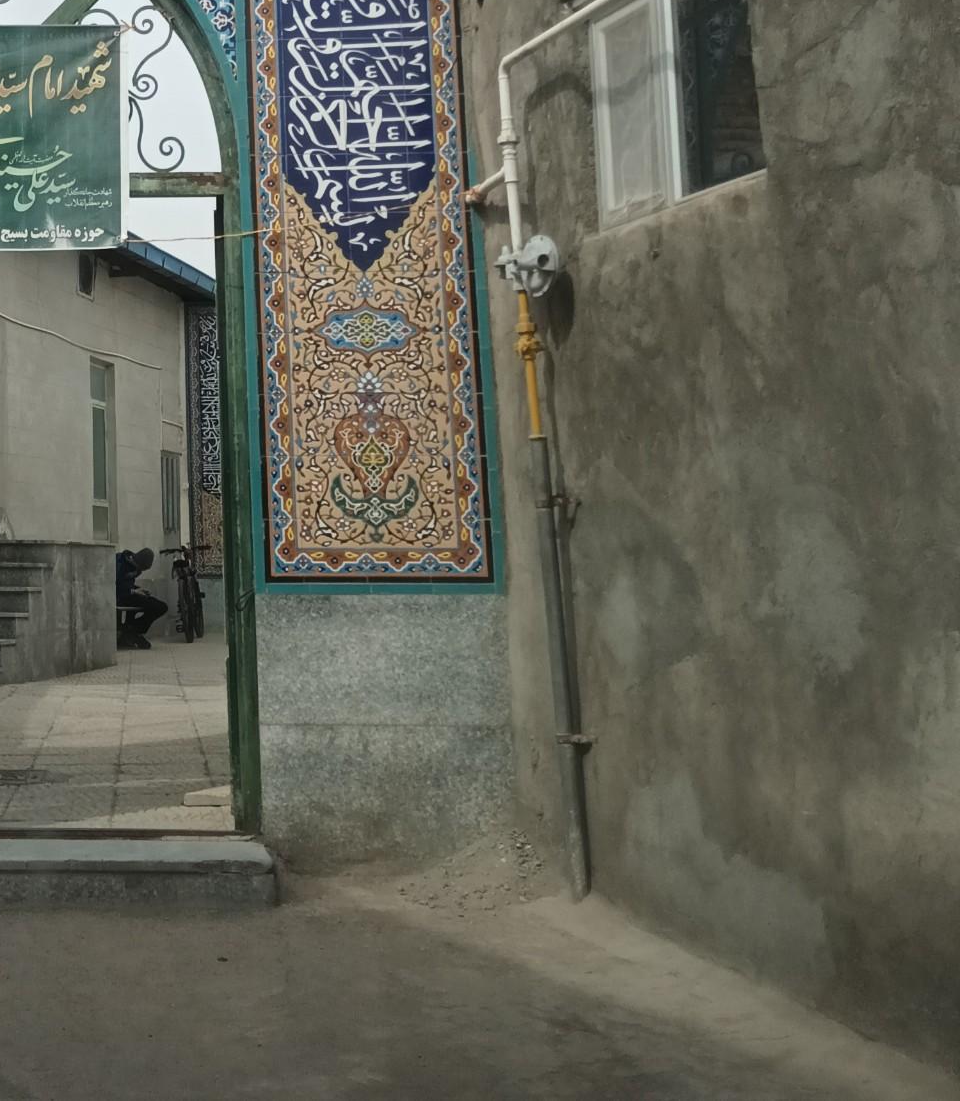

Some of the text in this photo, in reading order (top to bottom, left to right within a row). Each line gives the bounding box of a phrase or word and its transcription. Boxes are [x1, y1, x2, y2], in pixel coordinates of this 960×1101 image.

[29, 54, 64, 118] امام
[61, 41, 112, 115] شهید
[0, 226, 28, 243] بسیج
[31, 225, 72, 243] مقاومت
[74, 226, 105, 243] حوزه
